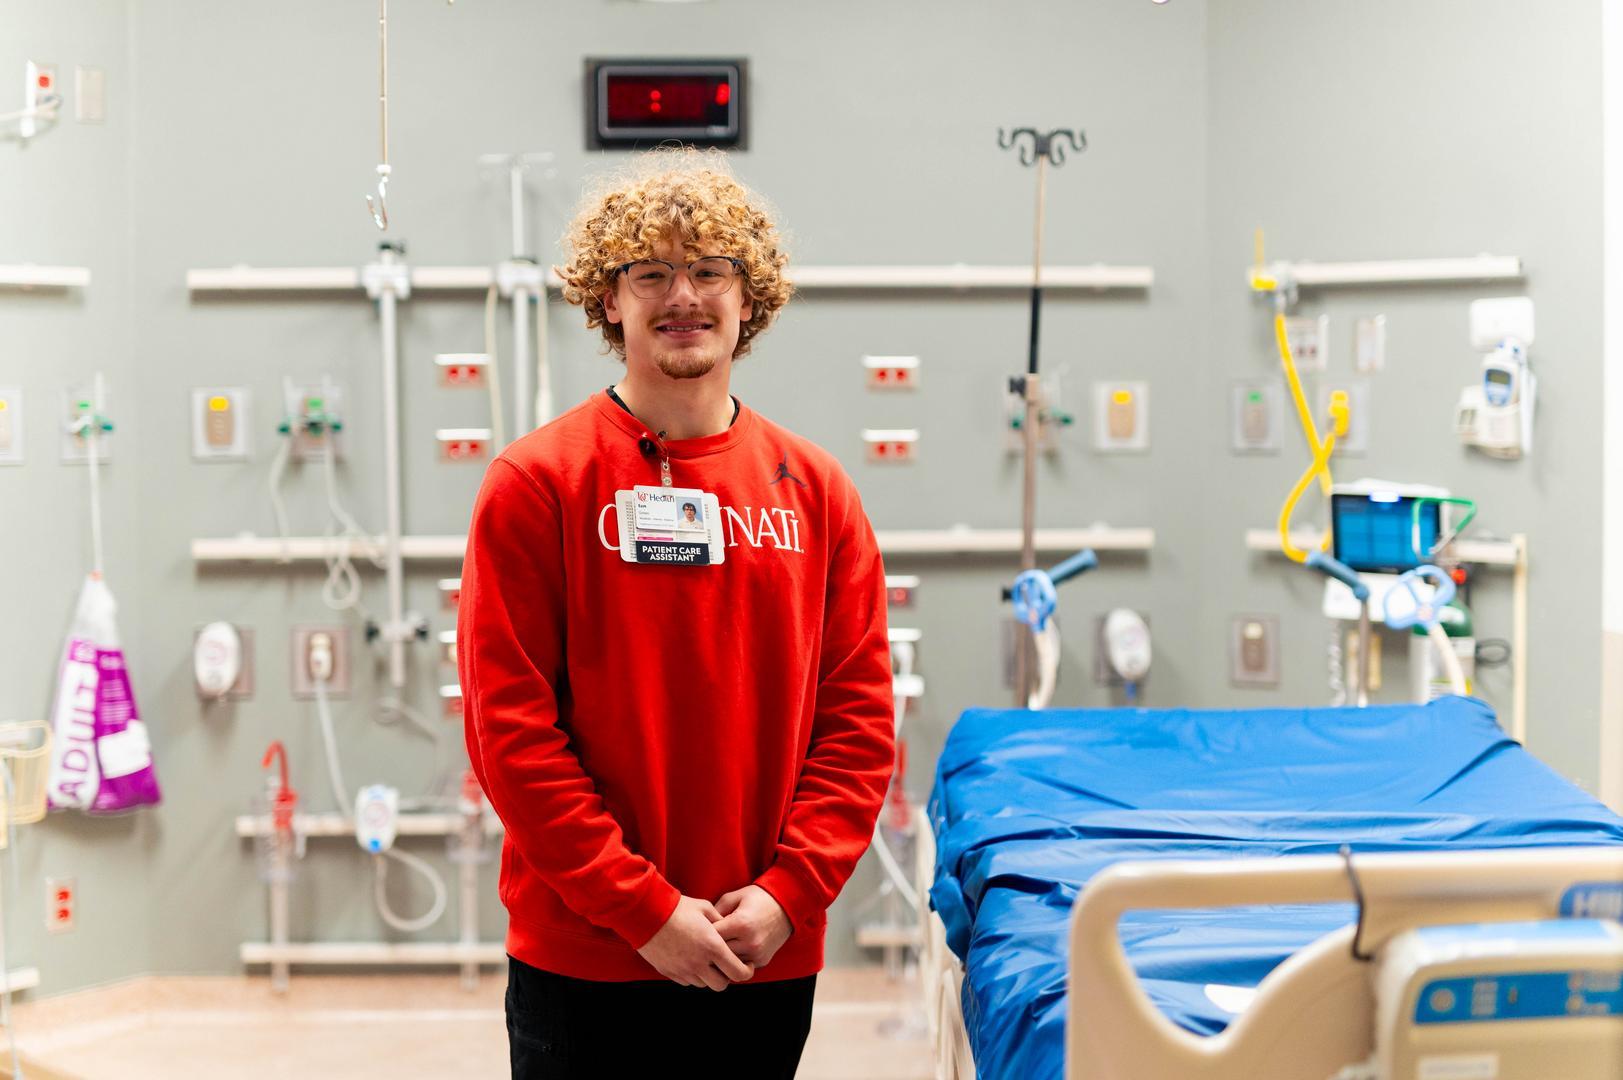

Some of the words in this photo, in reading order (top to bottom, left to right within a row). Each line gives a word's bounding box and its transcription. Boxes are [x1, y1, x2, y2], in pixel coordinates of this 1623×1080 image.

[641, 545, 678, 554] PATIENT
[678, 546, 702, 555] CARE
[649, 553, 695, 562] ASSISTANT
[58, 680, 96, 800] ADULT
